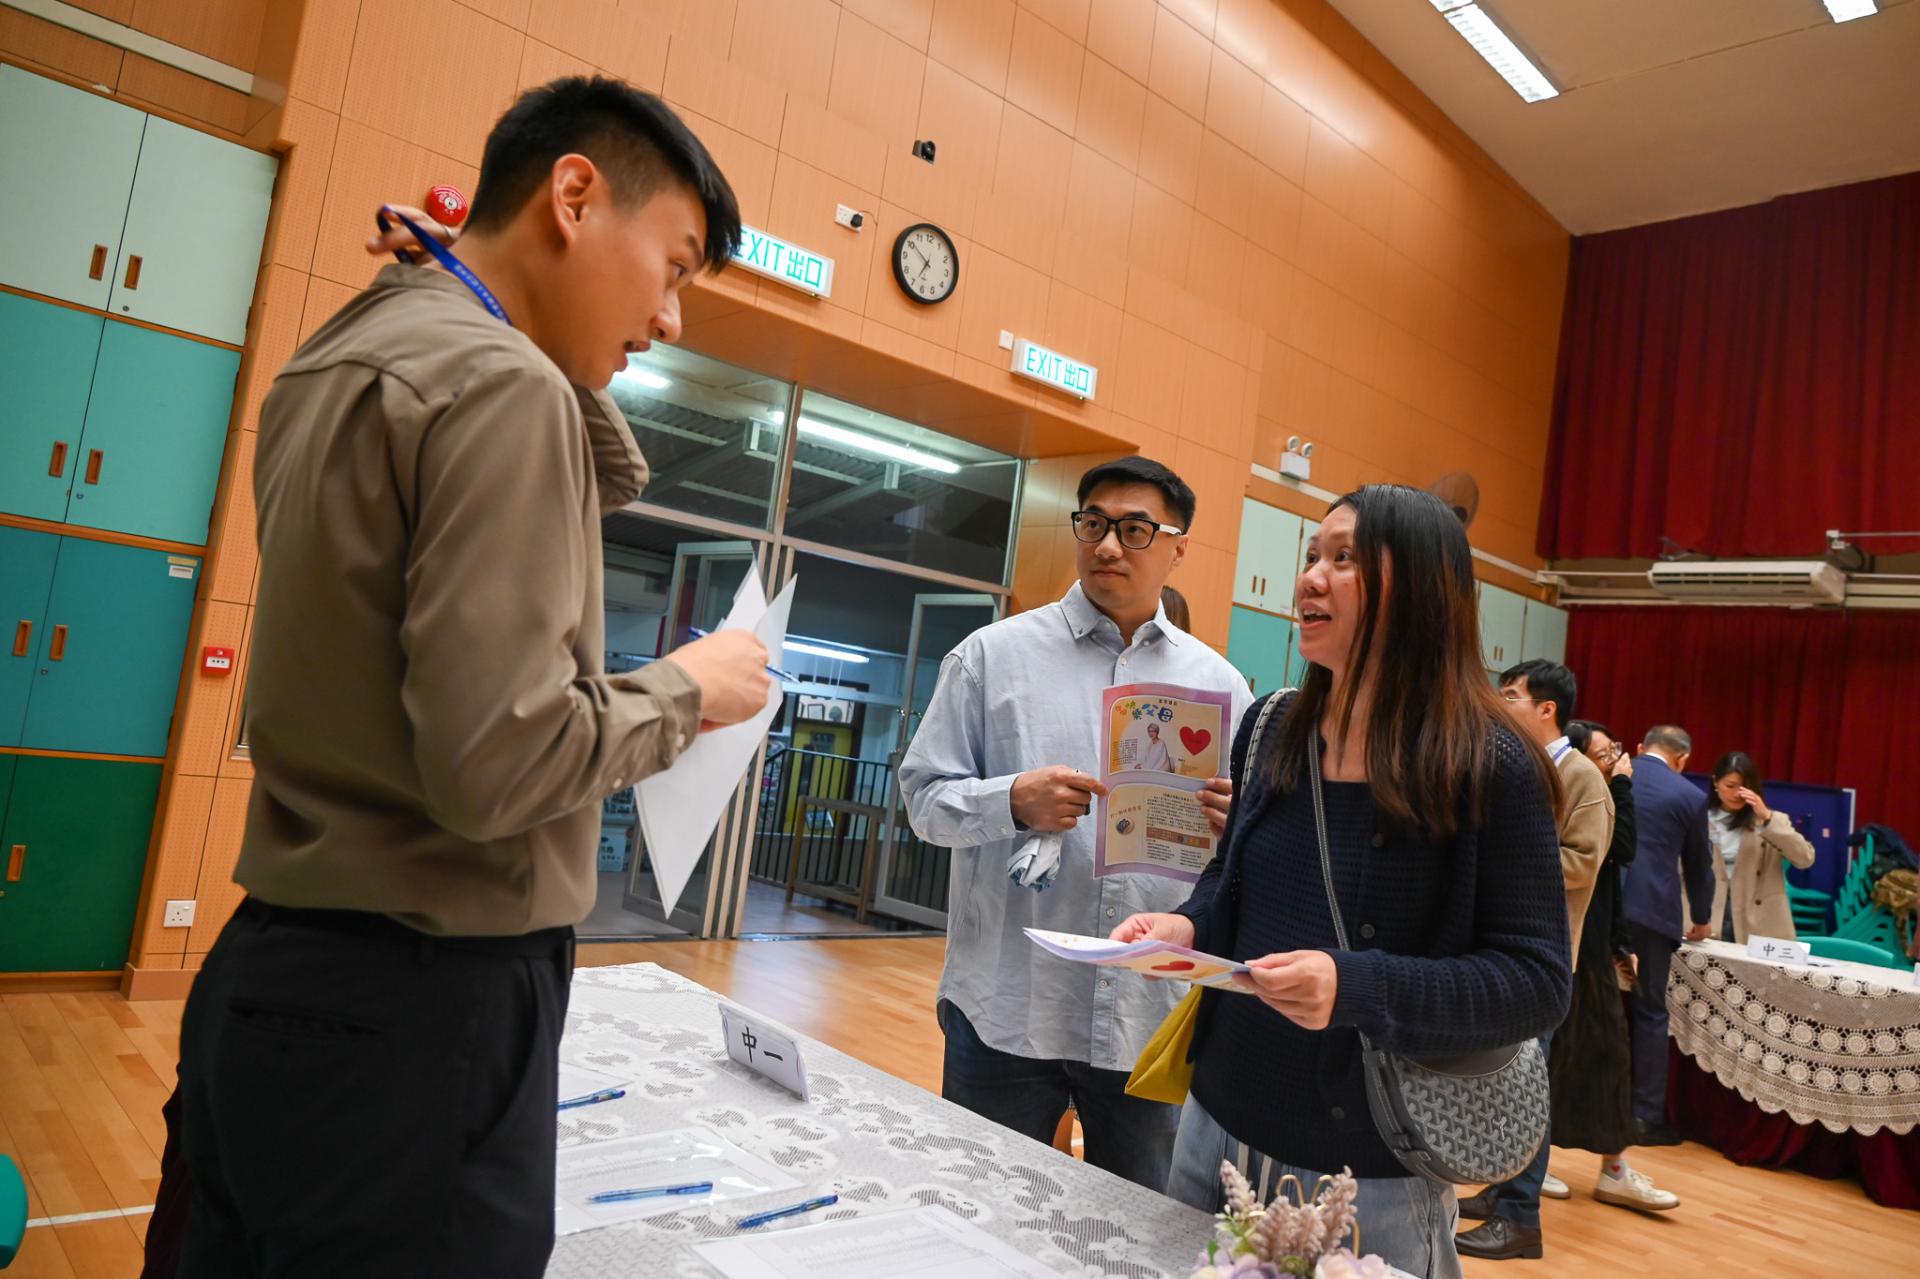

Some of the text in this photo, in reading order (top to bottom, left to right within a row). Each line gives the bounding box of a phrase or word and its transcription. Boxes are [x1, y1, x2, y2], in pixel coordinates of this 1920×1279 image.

[786, 250, 823, 288] 出口
[1026, 347, 1089, 392] EXIT 出口
[1762, 943, 1795, 959] 中三
[741, 1025, 784, 1063] 中一
